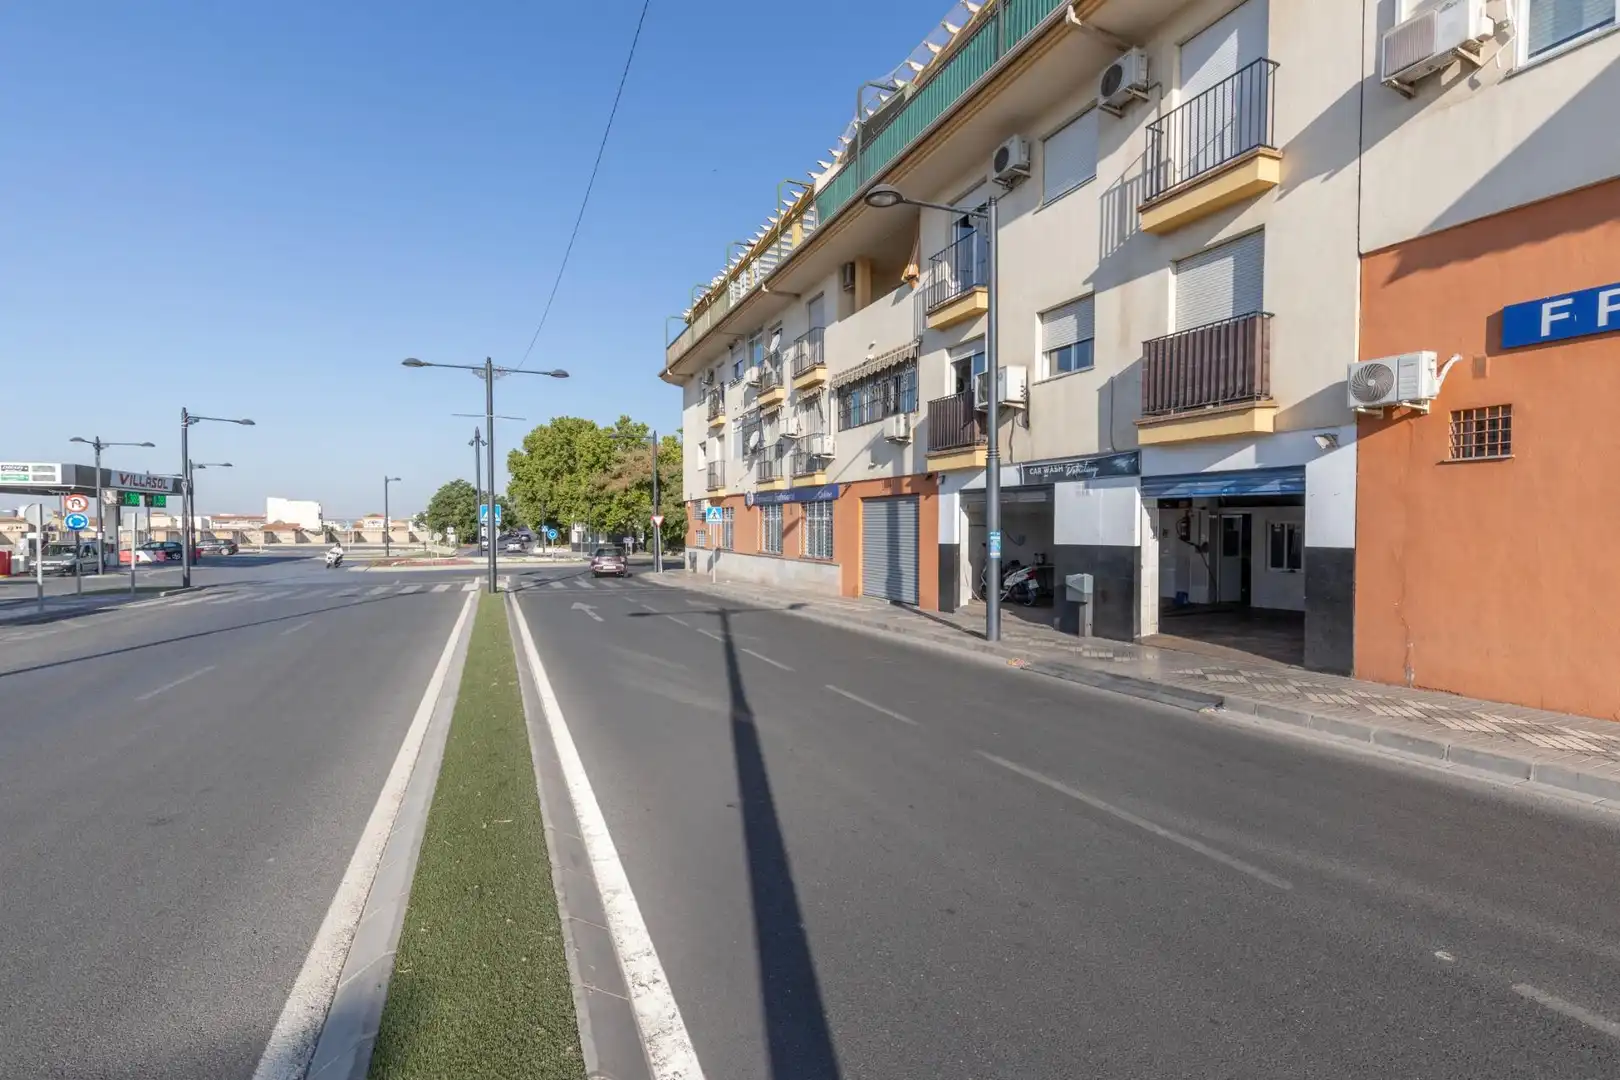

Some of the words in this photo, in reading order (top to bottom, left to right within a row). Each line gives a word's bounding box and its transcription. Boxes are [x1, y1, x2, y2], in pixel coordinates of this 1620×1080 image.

[1029, 467, 1041, 475] CAR
[1043, 465, 1064, 475] WASH
[119, 474, 168, 489] VILLASOL
